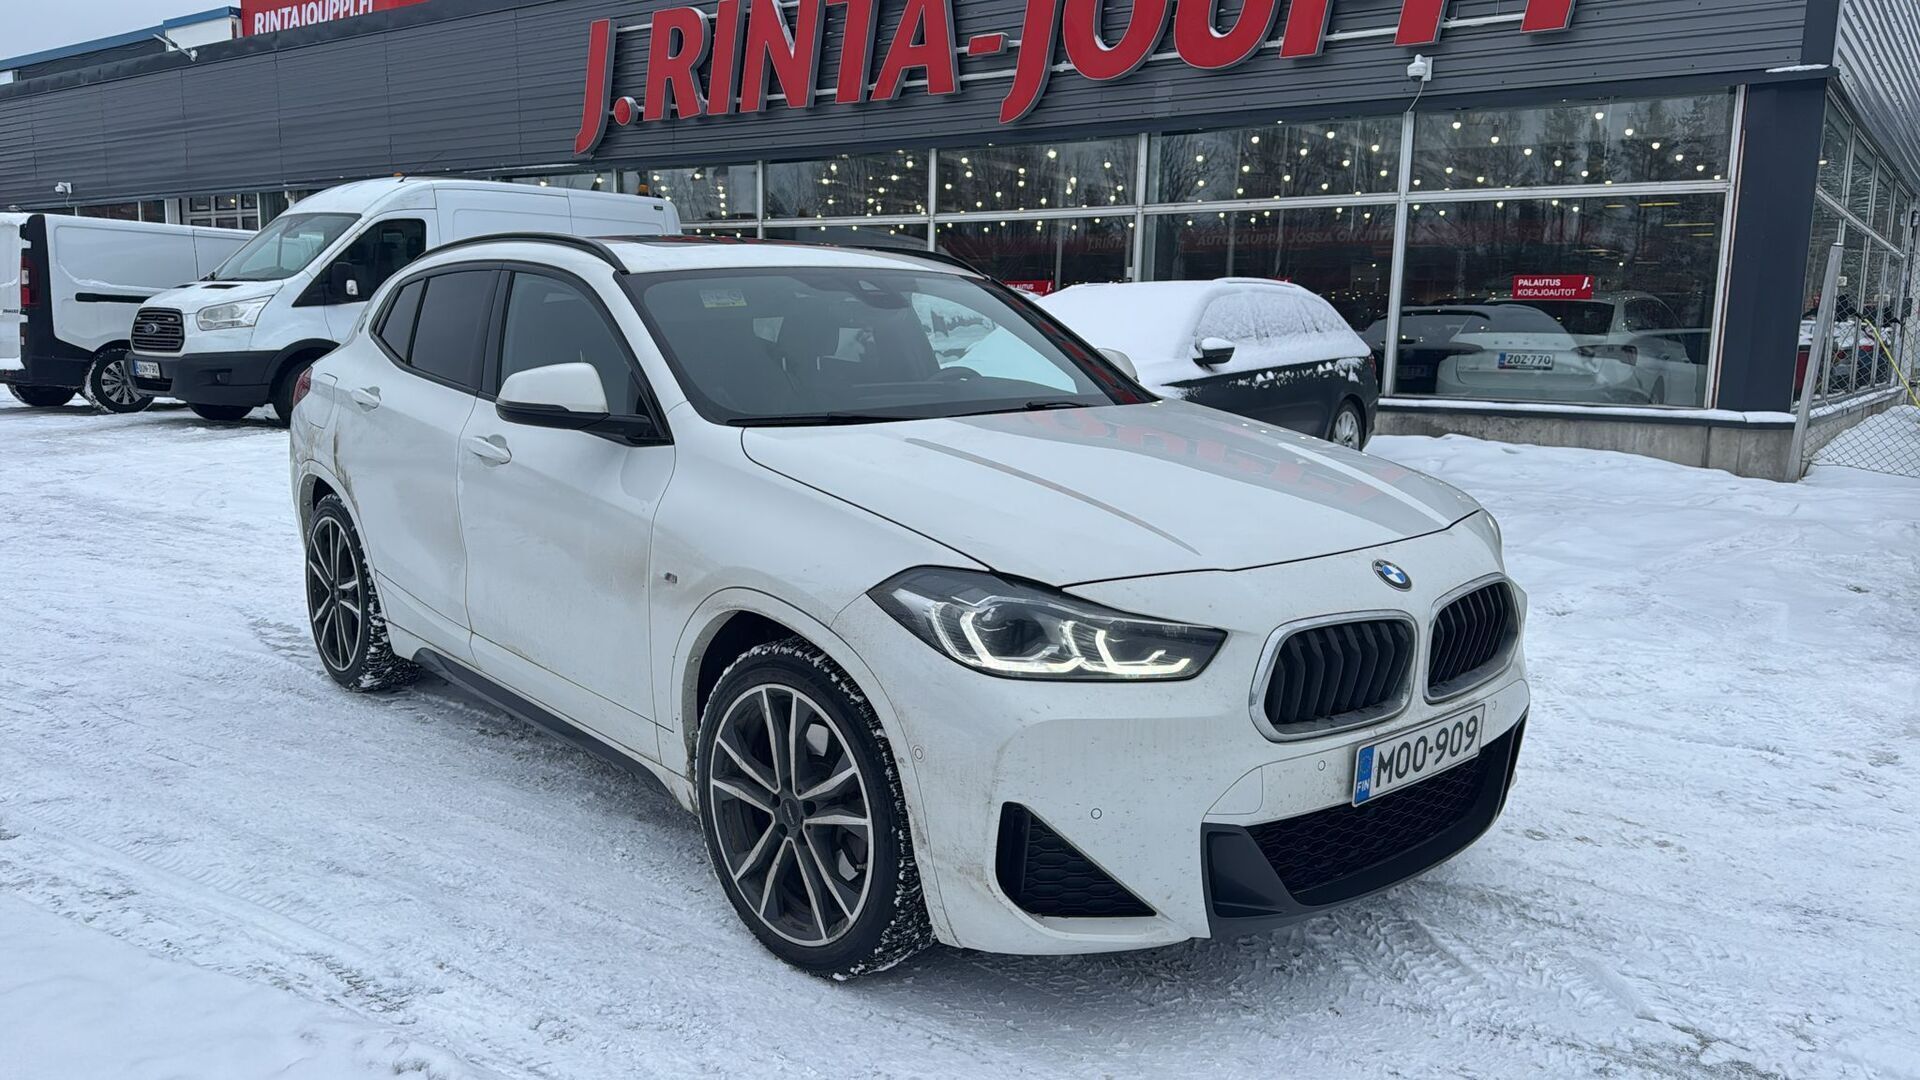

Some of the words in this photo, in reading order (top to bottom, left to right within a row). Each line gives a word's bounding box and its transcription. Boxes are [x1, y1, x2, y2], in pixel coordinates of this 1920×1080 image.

[574, 0, 1571, 155] J.RINTA-JOU
[1518, 279, 1561, 287] PALAUTUS
[1517, 288, 1576, 296] KOEAJOAUTOT
[1507, 354, 1551, 365] ZOZ-770
[1375, 715, 1479, 788] MOO-909
[1356, 778, 1370, 793] FIN
